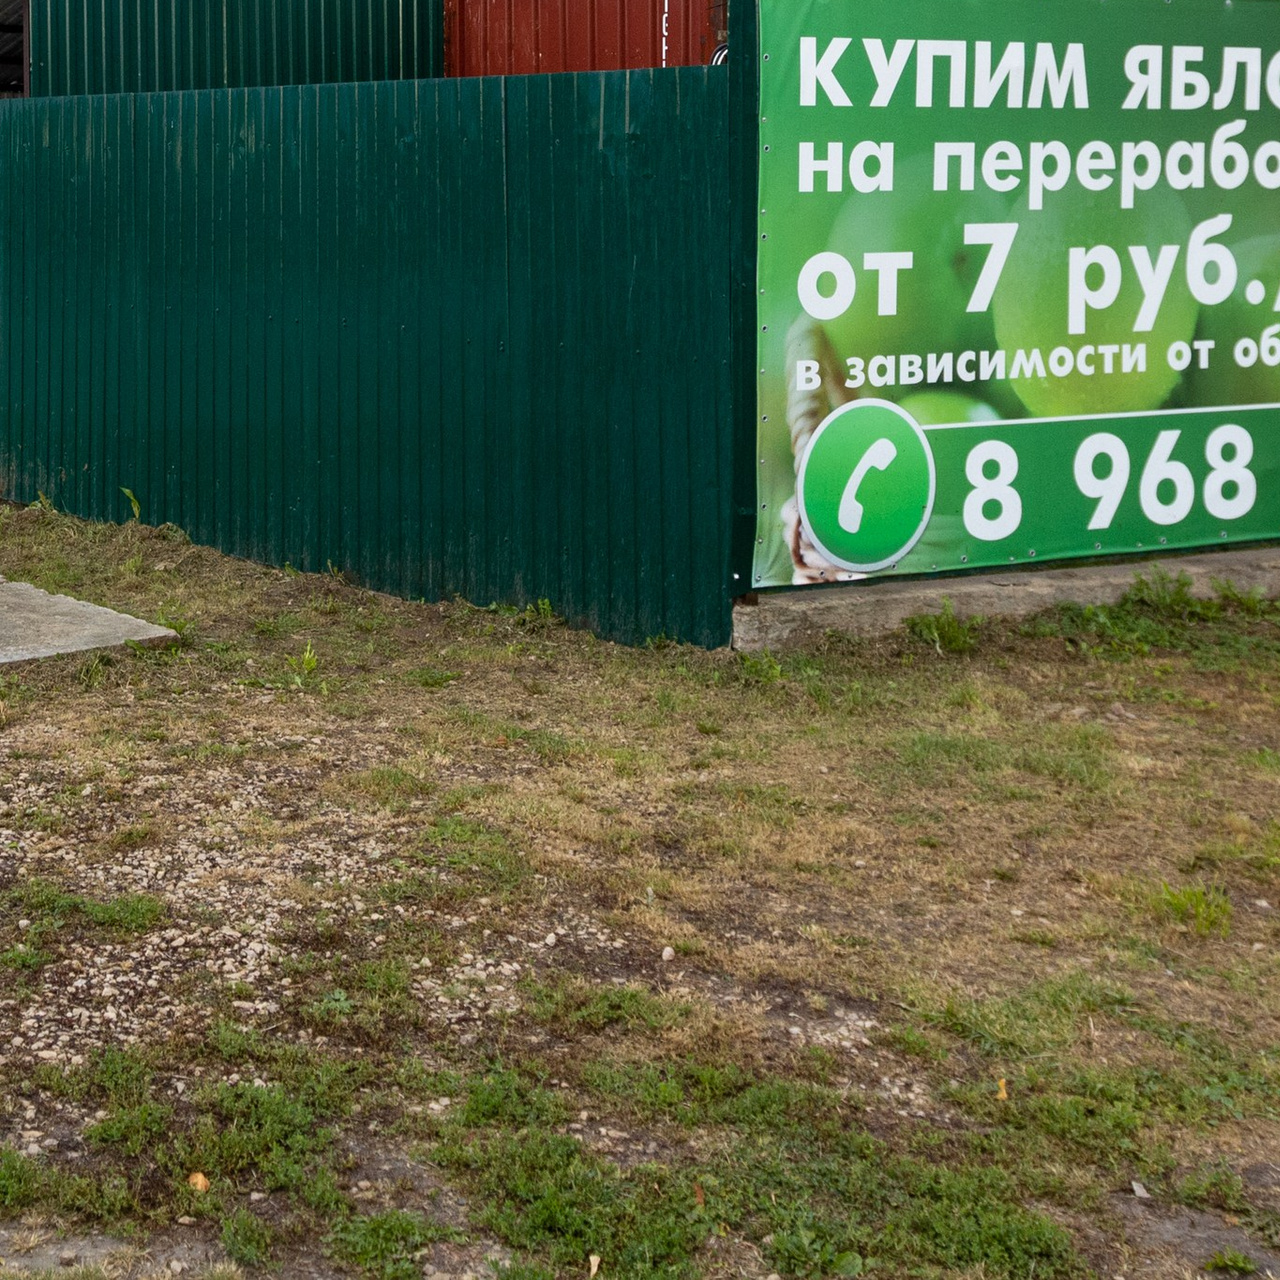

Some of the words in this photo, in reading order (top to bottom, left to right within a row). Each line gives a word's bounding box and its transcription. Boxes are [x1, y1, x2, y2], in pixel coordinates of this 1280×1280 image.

[799, 36, 1090, 109] КУПИМ
[797, 139, 895, 195] на
[796, 251, 913, 321] от
[963, 222, 1019, 313] 7
[795, 359, 822, 391] в
[844, 343, 1148, 389] зависимости
[1166, 339, 1216, 372] от
[962, 439, 1023, 542] 8
[1073, 423, 1257, 531] 968
